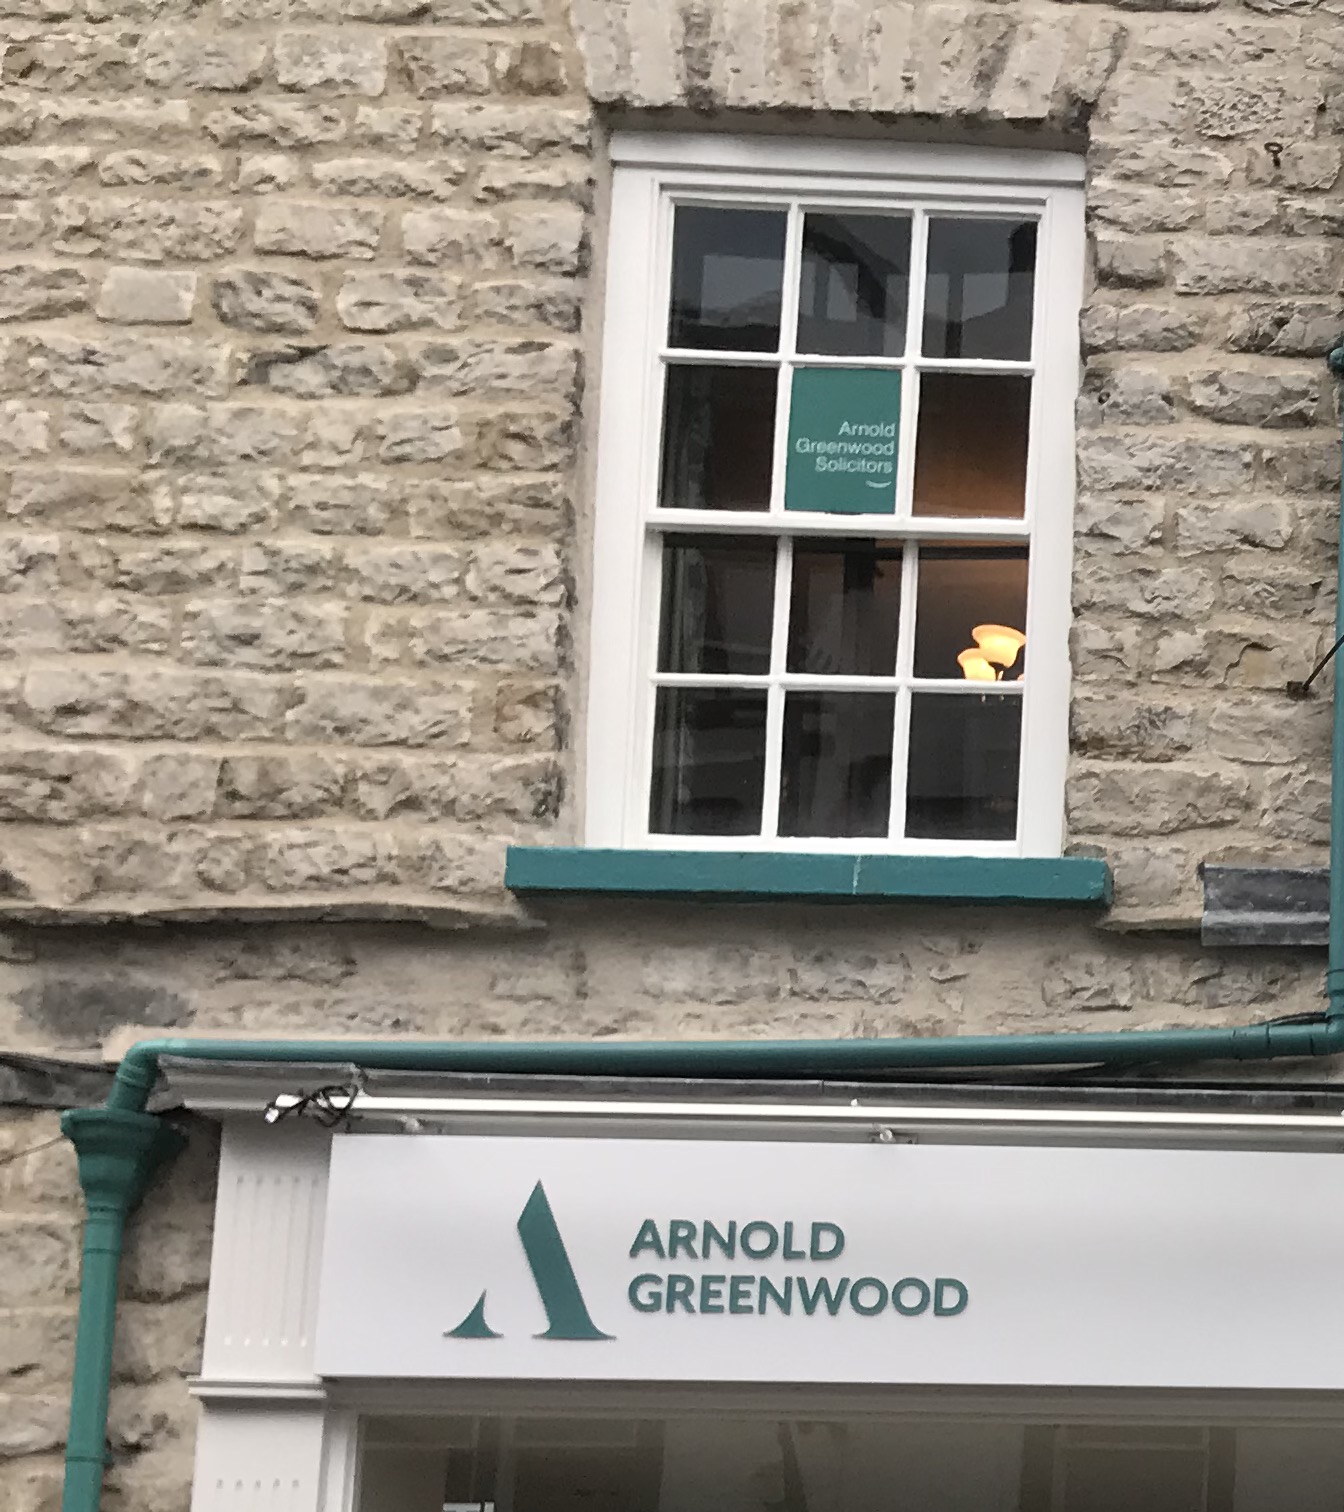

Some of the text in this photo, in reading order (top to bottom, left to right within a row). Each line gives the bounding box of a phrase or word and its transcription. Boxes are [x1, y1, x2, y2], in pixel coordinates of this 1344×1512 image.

[838, 421, 896, 438] Arnold
[795, 437, 895, 456] Greenwood
[815, 456, 893, 474] Solicitors
[628, 1218, 845, 1261] ARNOLD
[628, 1273, 969, 1317] GREENWOOD
